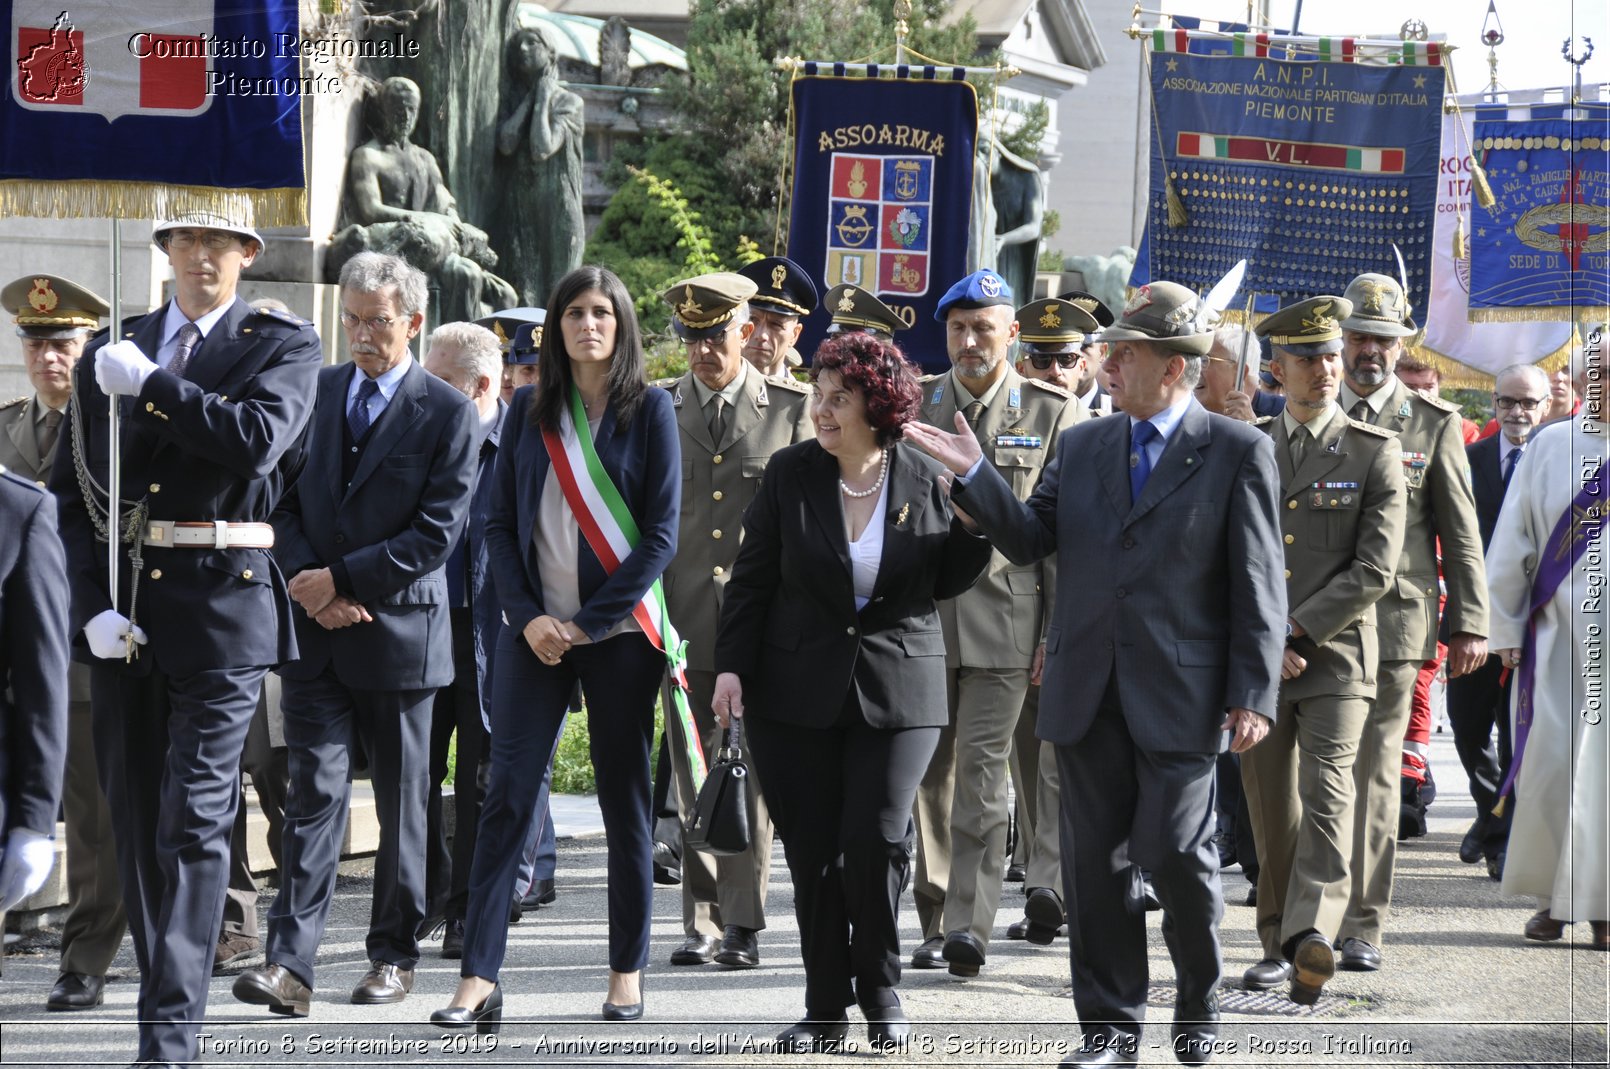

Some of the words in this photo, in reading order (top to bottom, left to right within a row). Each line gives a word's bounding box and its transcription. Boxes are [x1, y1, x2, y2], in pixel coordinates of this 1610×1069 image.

[1253, 63, 1333, 86] A.N.P.I.
[1162, 77, 1241, 95] ASSOCIAZIONE
[1243, 84, 1312, 101] NAZIONALE
[1315, 89, 1374, 105] PARTIGIANI
[1377, 93, 1428, 106] D'ITALIA
[1245, 101, 1335, 123] PIEMONTE
[818, 124, 945, 157] ASSOARMA
[1530, 169, 1571, 185] FAMIGLIE
[1512, 193, 1528, 205] LA
[1534, 184, 1567, 198] CAUSA
[1575, 184, 1586, 195] DI
[1509, 255, 1540, 269] SEDE
[1546, 255, 1559, 269] DI
